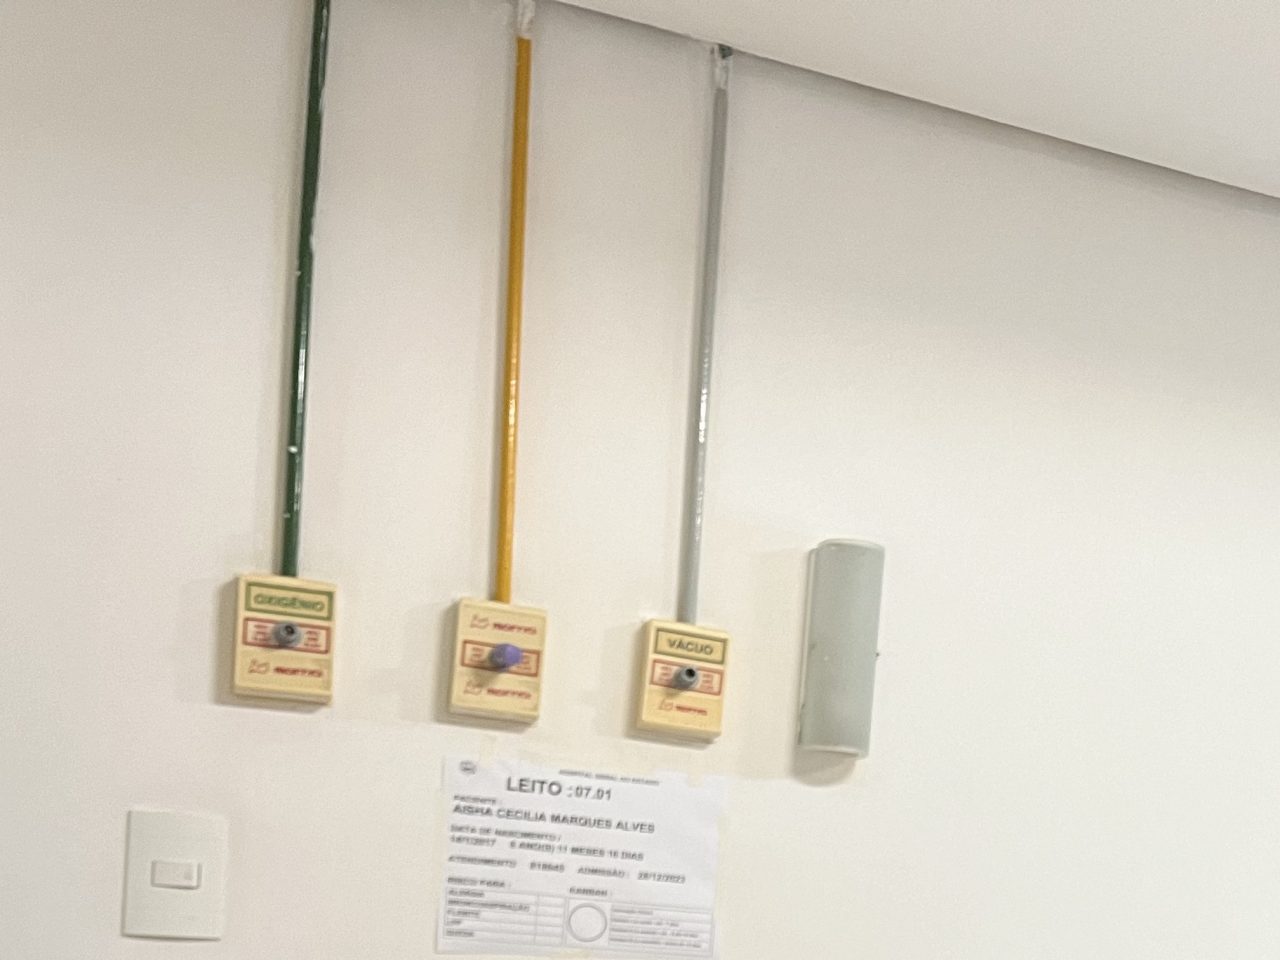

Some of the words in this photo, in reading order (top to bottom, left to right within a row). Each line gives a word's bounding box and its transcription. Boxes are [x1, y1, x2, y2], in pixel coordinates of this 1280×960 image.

[254, 593, 325, 612] OXIGÊNIO
[667, 636, 714, 655] VÁCUO
[506, 776, 562, 796] LEITO
[453, 804, 493, 817] AISHA
[496, 808, 547, 822] CECILIA
[550, 814, 612, 828] MARQUES
[615, 820, 655, 833] ALVES
